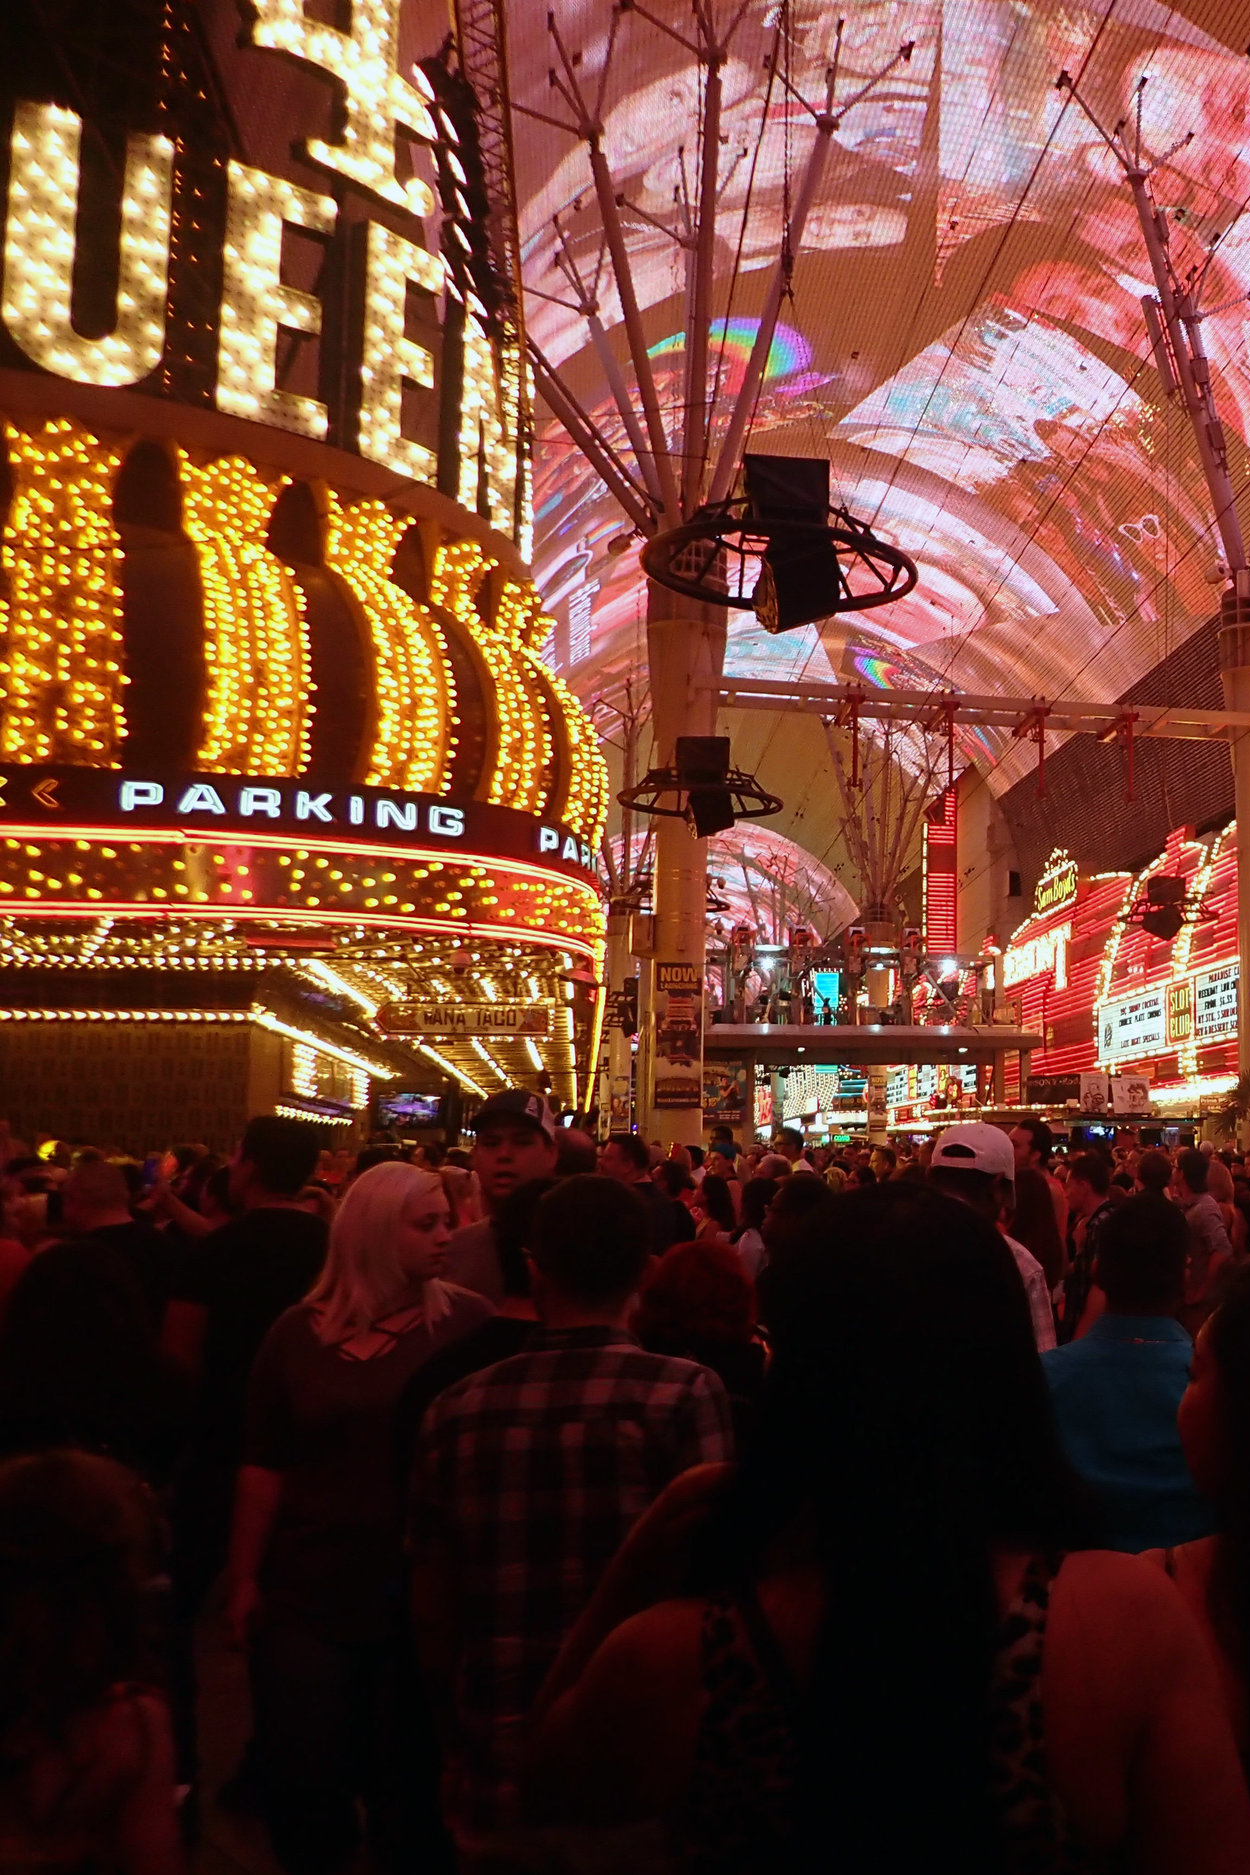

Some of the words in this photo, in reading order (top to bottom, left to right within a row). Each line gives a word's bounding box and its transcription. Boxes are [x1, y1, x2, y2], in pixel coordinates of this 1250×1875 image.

[3, 102, 533, 566] UEEN
[120, 780, 464, 837] PARKING
[540, 825, 597, 875] PAR
[1037, 885, 1053, 911] Sam
[1053, 866, 1075, 901] Boyd's
[660, 966, 698, 982] NOW
[1169, 986, 1191, 1013] SLOT
[1169, 1013, 1191, 1038] CLUB
